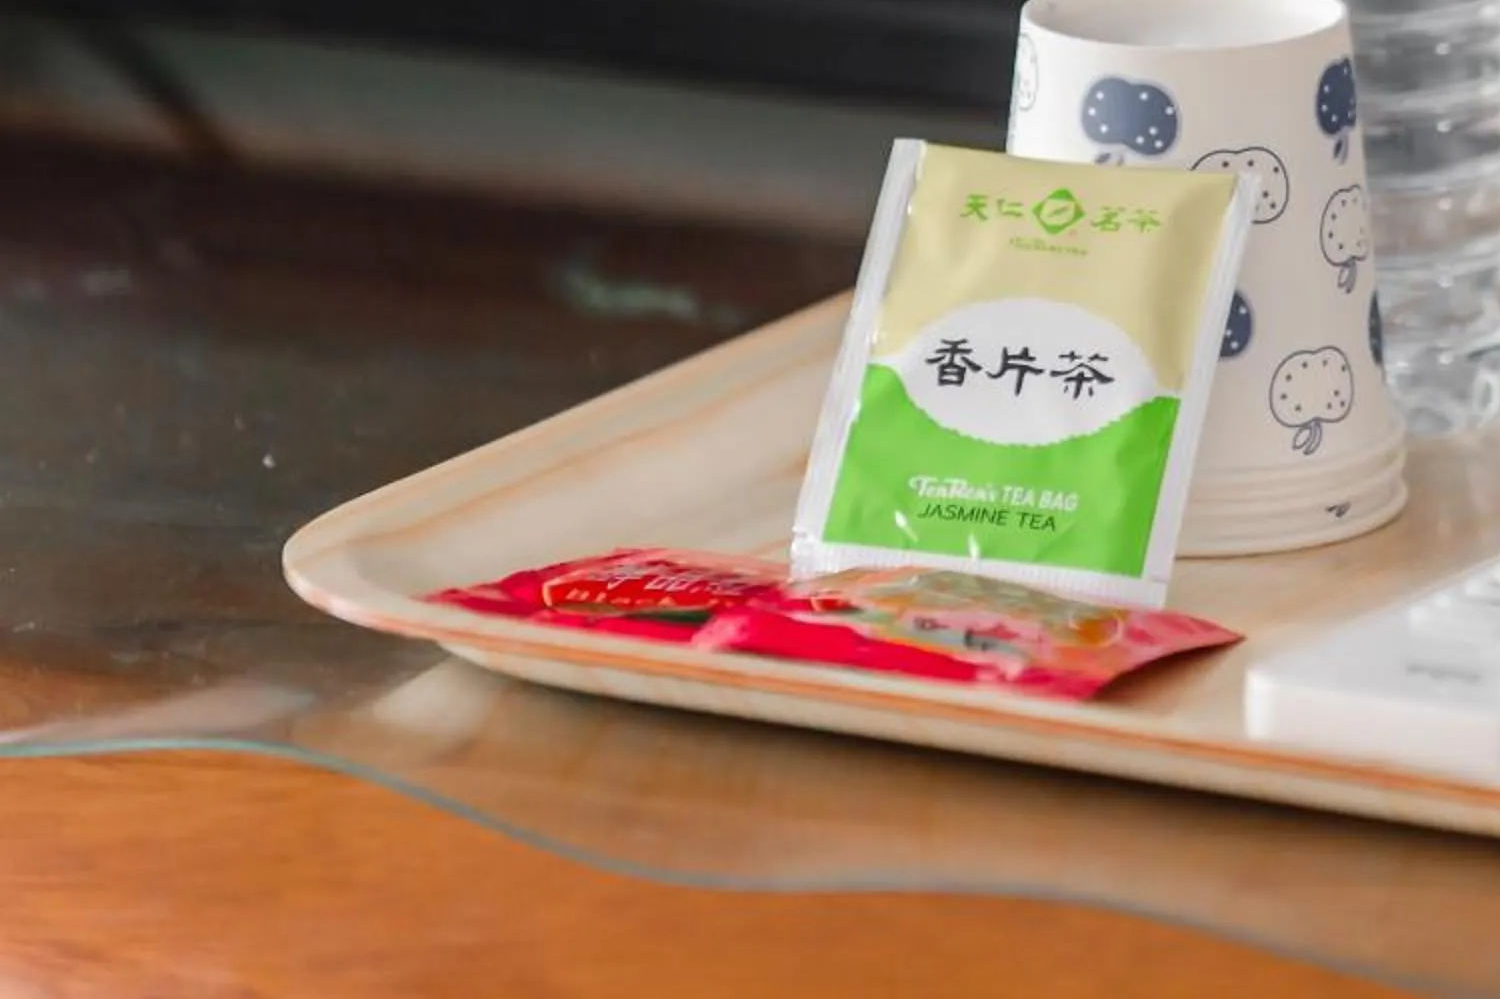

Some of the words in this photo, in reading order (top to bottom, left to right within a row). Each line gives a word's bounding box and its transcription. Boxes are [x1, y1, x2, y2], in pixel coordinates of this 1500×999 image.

[959, 193, 1025, 222] 天仁
[1090, 205, 1162, 234] 茗茶
[924, 338, 1116, 400] 香片茶
[1001, 485, 1035, 507] TEA
[1038, 490, 1080, 512] BAG
[916, 503, 1009, 527] JASMINE
[1016, 511, 1057, 532] TEA
